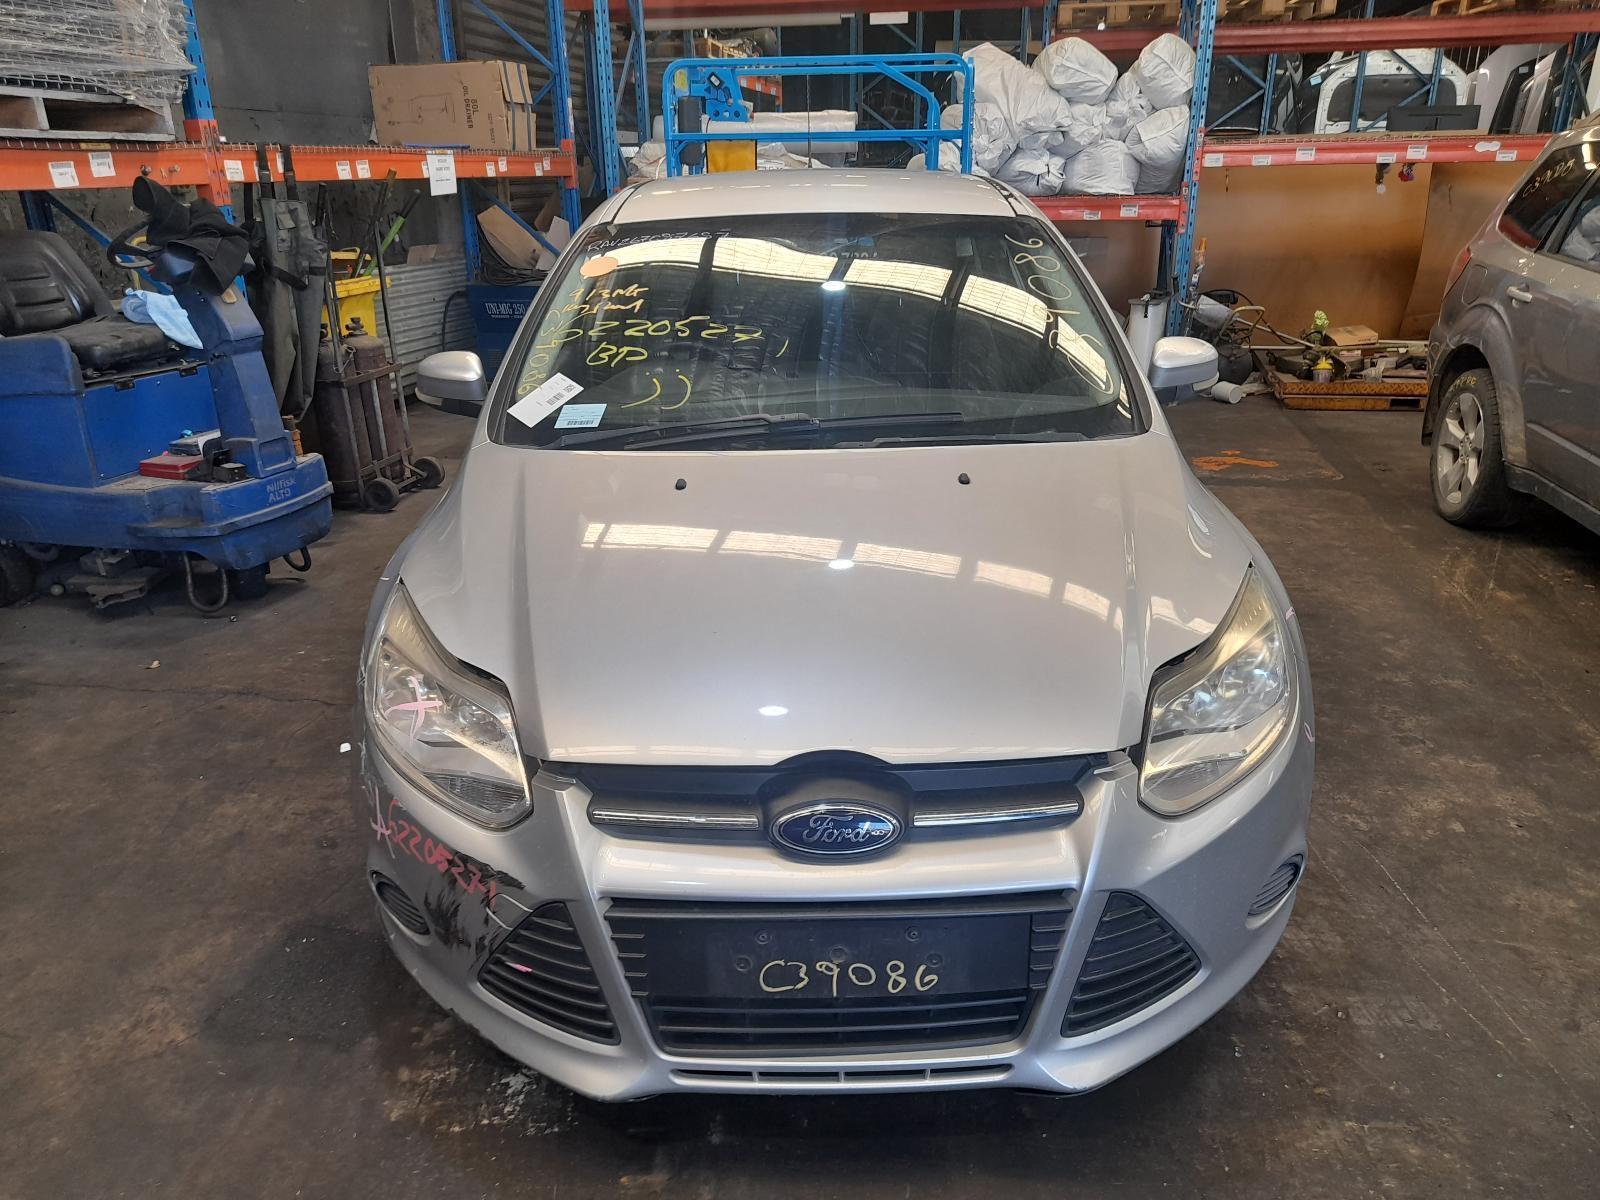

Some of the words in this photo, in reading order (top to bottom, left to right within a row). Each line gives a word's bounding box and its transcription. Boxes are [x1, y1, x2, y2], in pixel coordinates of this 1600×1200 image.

[464, 98, 474, 129] DRAINER
[802, 814, 873, 844] Ford
[759, 959, 939, 998] C39086
